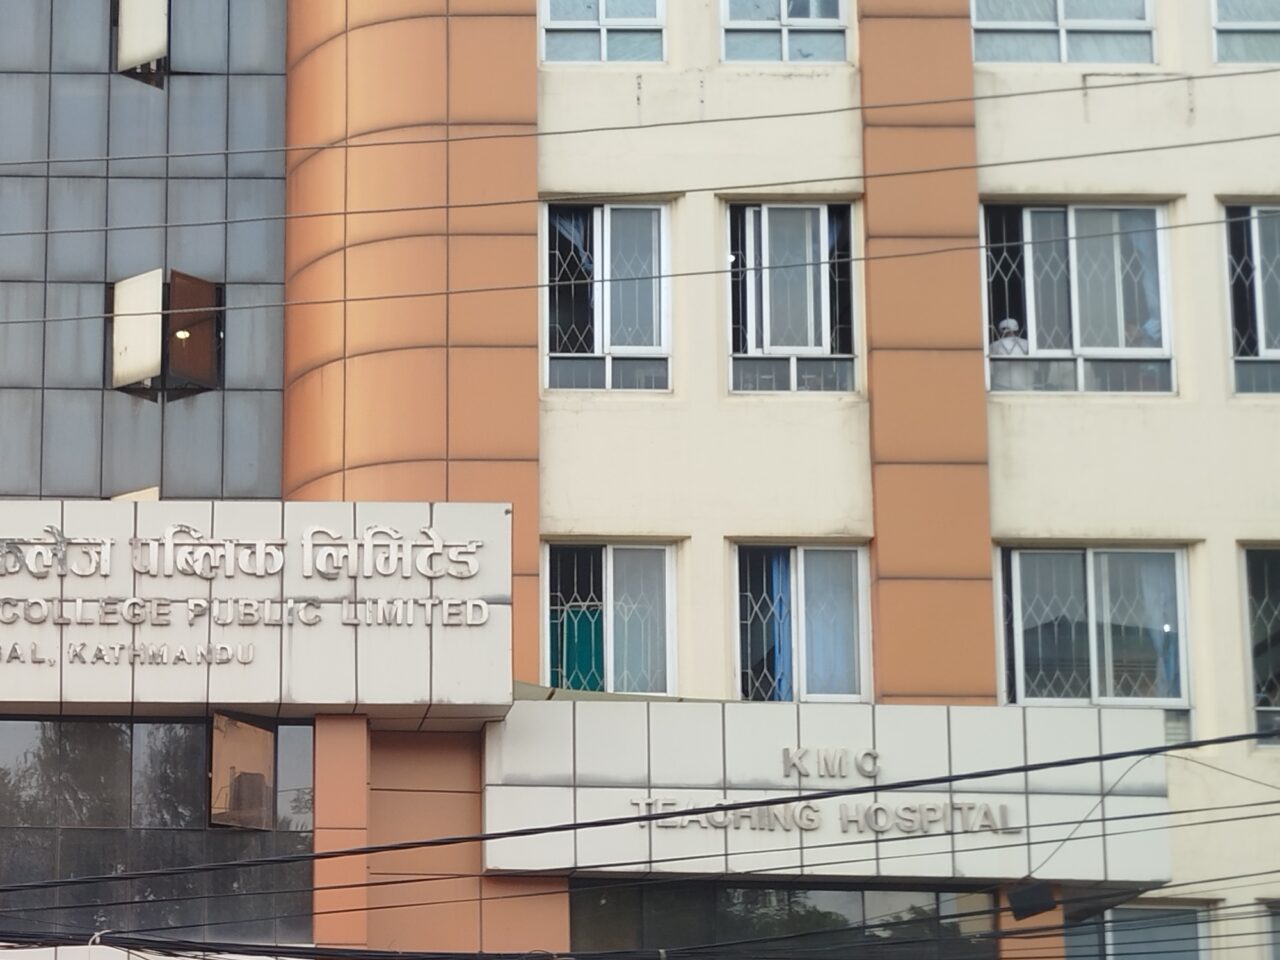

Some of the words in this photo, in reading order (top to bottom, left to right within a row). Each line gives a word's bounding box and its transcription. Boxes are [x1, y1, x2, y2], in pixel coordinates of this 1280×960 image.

[129, 523, 287, 580] पब्लिक
[301, 524, 484, 580] लिमिटेड
[187, 597, 322, 627] PUBLIC
[342, 597, 490, 627] LIMITED
[68, 642, 256, 666] KATHMANDU
[782, 746, 881, 779] KMC
[630, 798, 821, 832] TEACHING
[839, 800, 1022, 836] HOSPITAL
